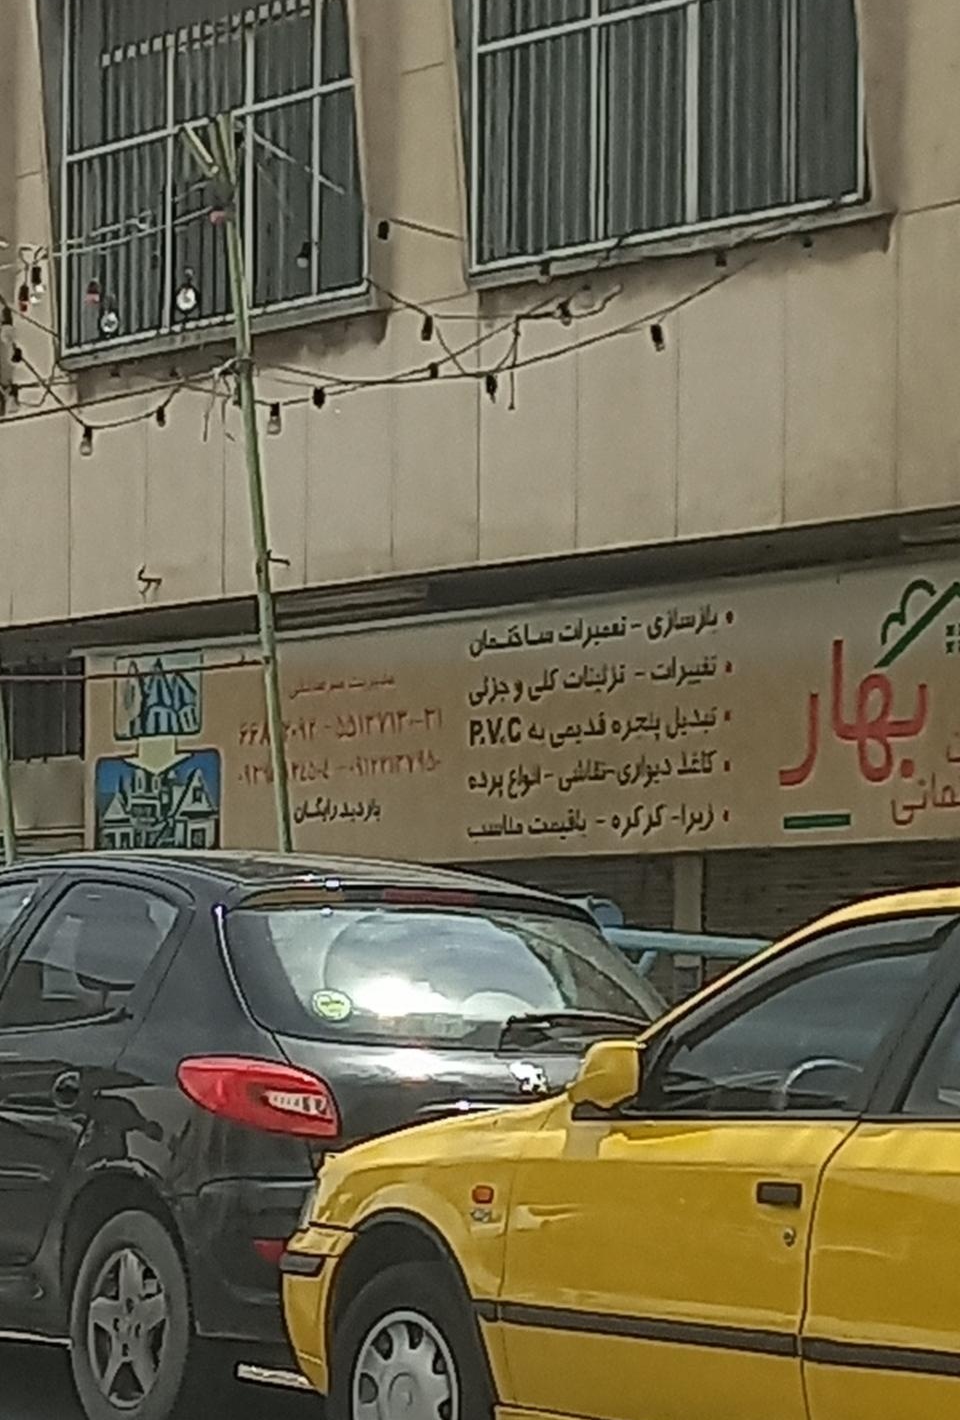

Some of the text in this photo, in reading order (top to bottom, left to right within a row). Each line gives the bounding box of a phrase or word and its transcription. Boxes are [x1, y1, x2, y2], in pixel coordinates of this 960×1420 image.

[469, 604, 718, 657] بازسازی تعمیرات ساختمان
[528, 668, 559, 702] کلی
[651, 656, 718, 686] تغییرات
[513, 679, 524, 703] و
[469, 706, 718, 749] تبدیل پنجره قدیمی به P.V.C
[779, 639, 928, 787] بهار
[676, 750, 718, 776] کاغذ
[467, 770, 503, 797] پرده
[293, 797, 382, 823] بازدید رایگان
[611, 803, 667, 837] کرکره
[466, 813, 523, 844] مناسب
